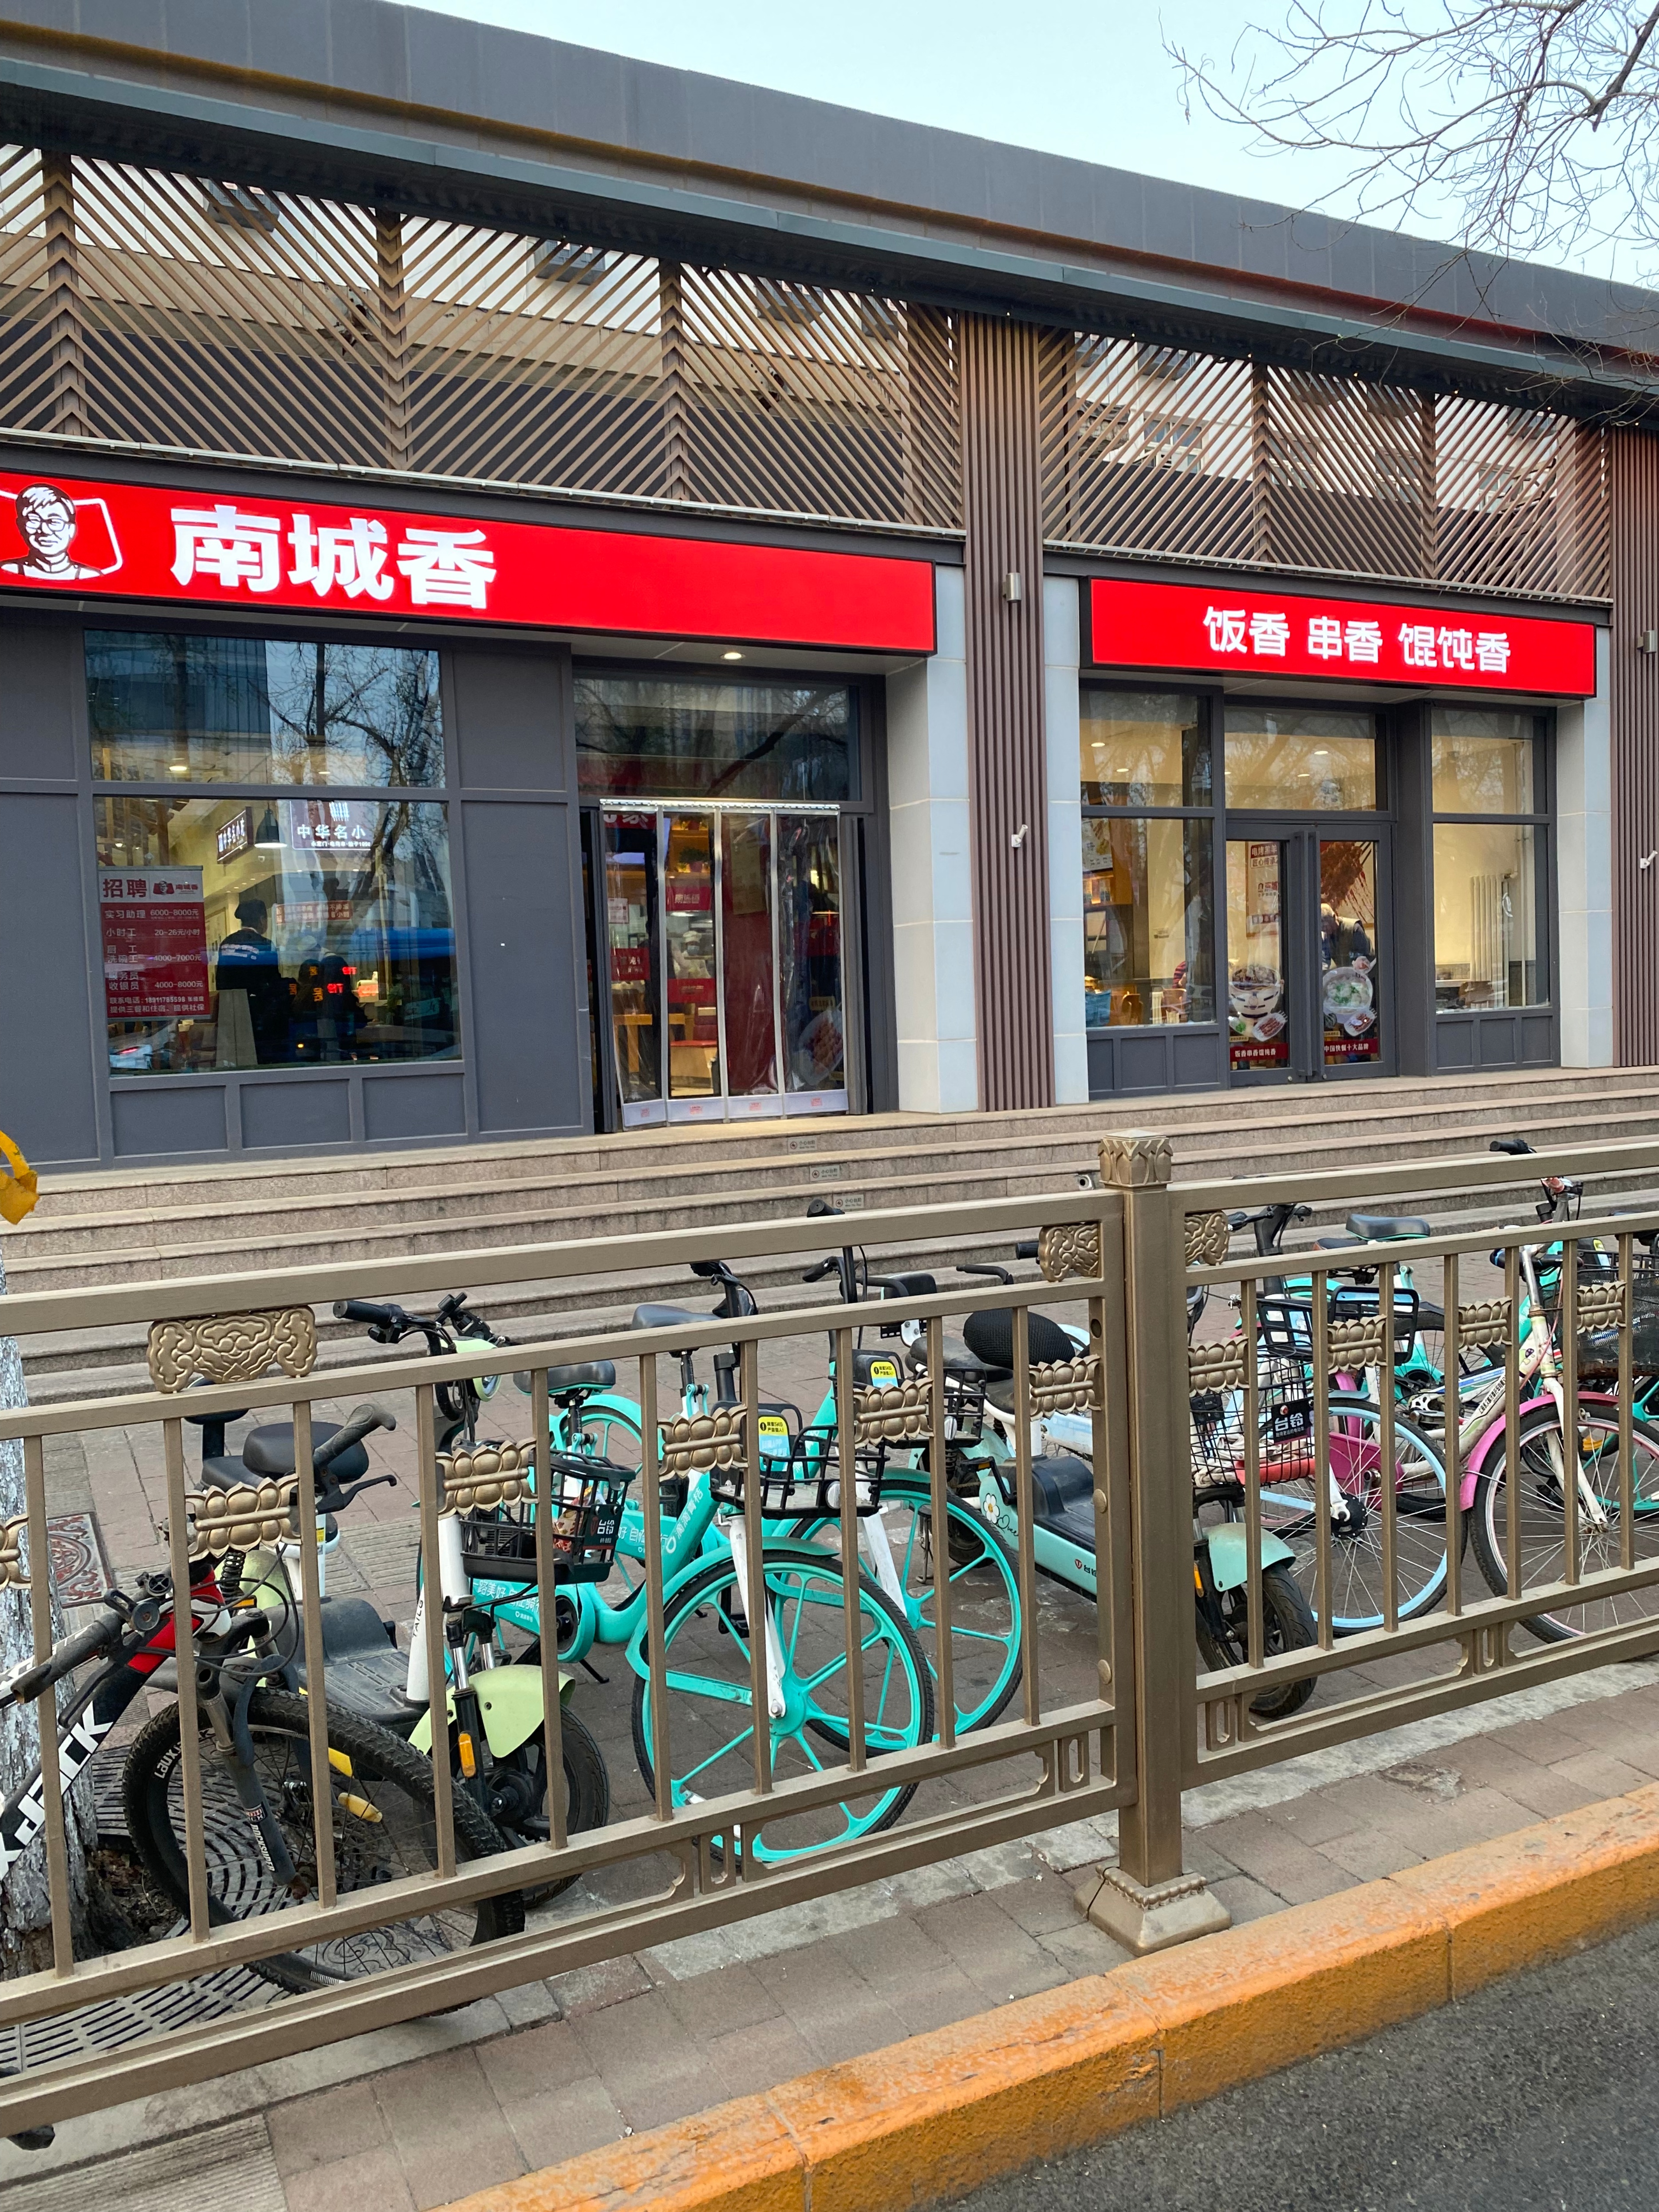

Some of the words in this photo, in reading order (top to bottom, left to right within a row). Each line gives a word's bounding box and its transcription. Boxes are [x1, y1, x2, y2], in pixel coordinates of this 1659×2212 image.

[170, 505, 497, 609] 南城香
[1203, 606, 1290, 656] 饭香
[1308, 615, 1383, 663] 串香
[1398, 623, 1511, 673] 馄饨香
[297, 824, 366, 839] 中华名小
[103, 879, 147, 898] 招聘
[105, 910, 146, 919] 实习助理
[106, 928, 136, 937] 小时工
[1275, 1412, 1304, 1432] 台铃
[597, 1519, 615, 1534] 台铃
[412, 1599, 423, 1638] TAILG
